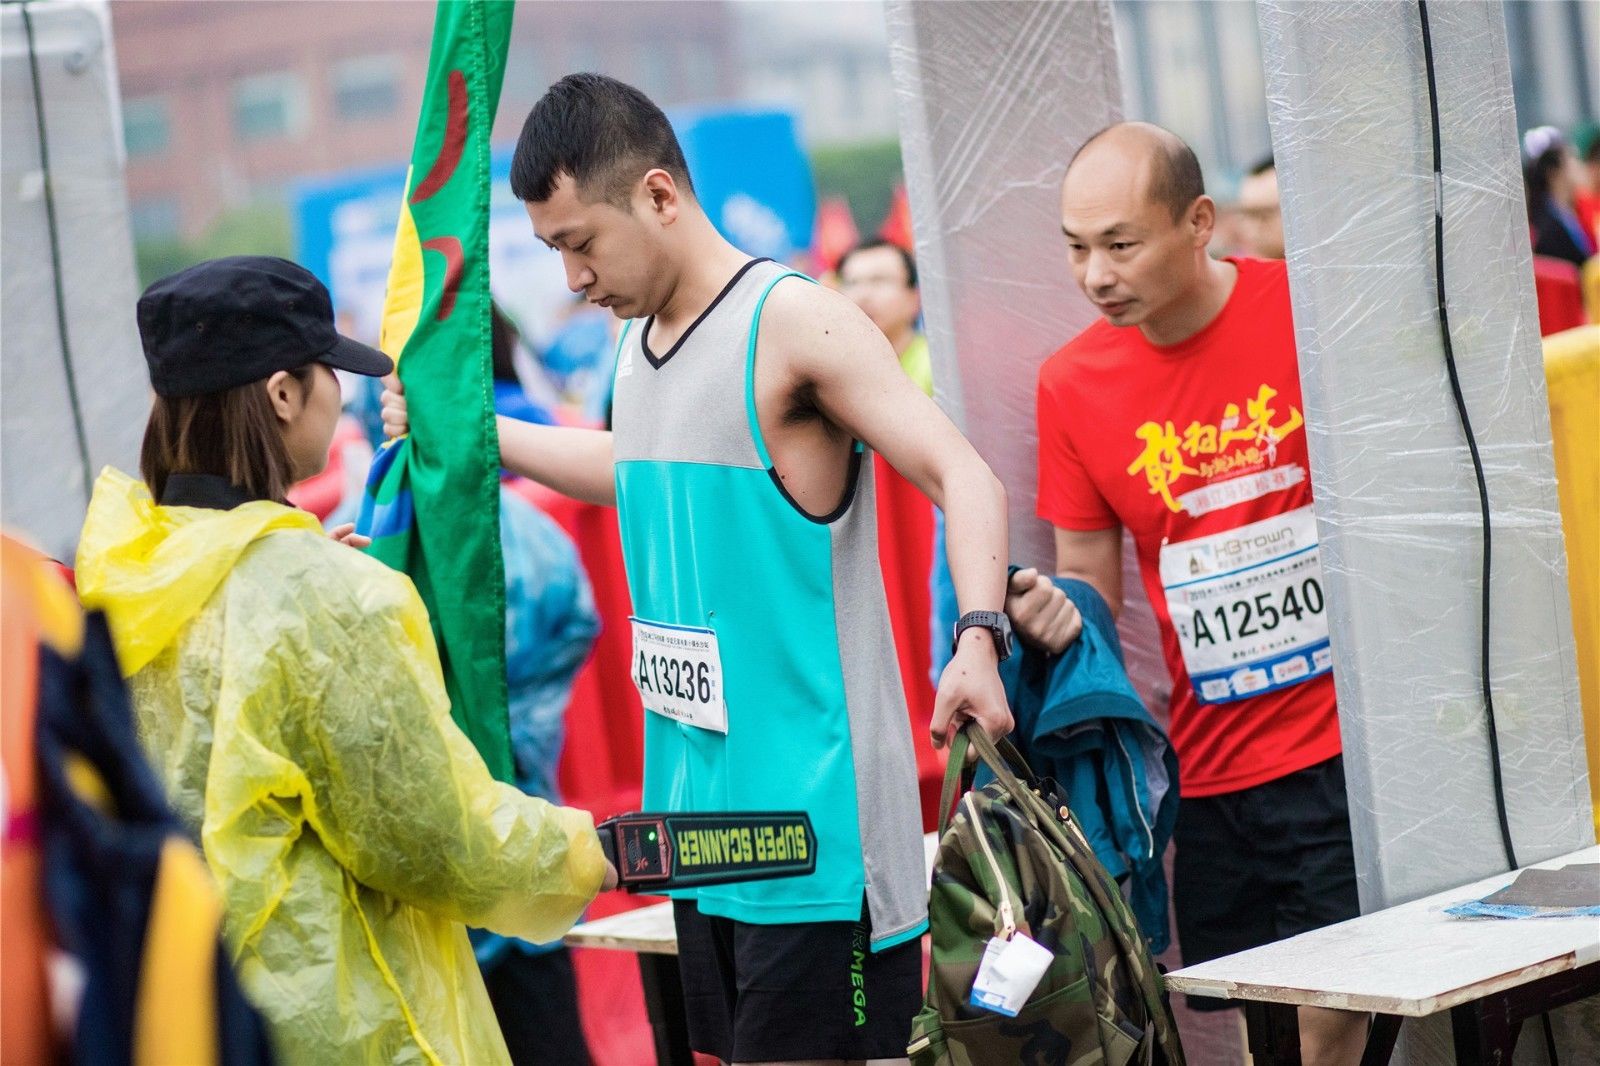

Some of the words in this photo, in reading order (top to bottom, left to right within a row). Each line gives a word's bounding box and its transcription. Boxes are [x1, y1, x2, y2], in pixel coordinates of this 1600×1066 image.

[1193, 577, 1325, 649] A12540
[639, 650, 711, 704] A13236
[677, 827, 753, 866] SCANNER
[754, 825, 808, 862] SUPER
